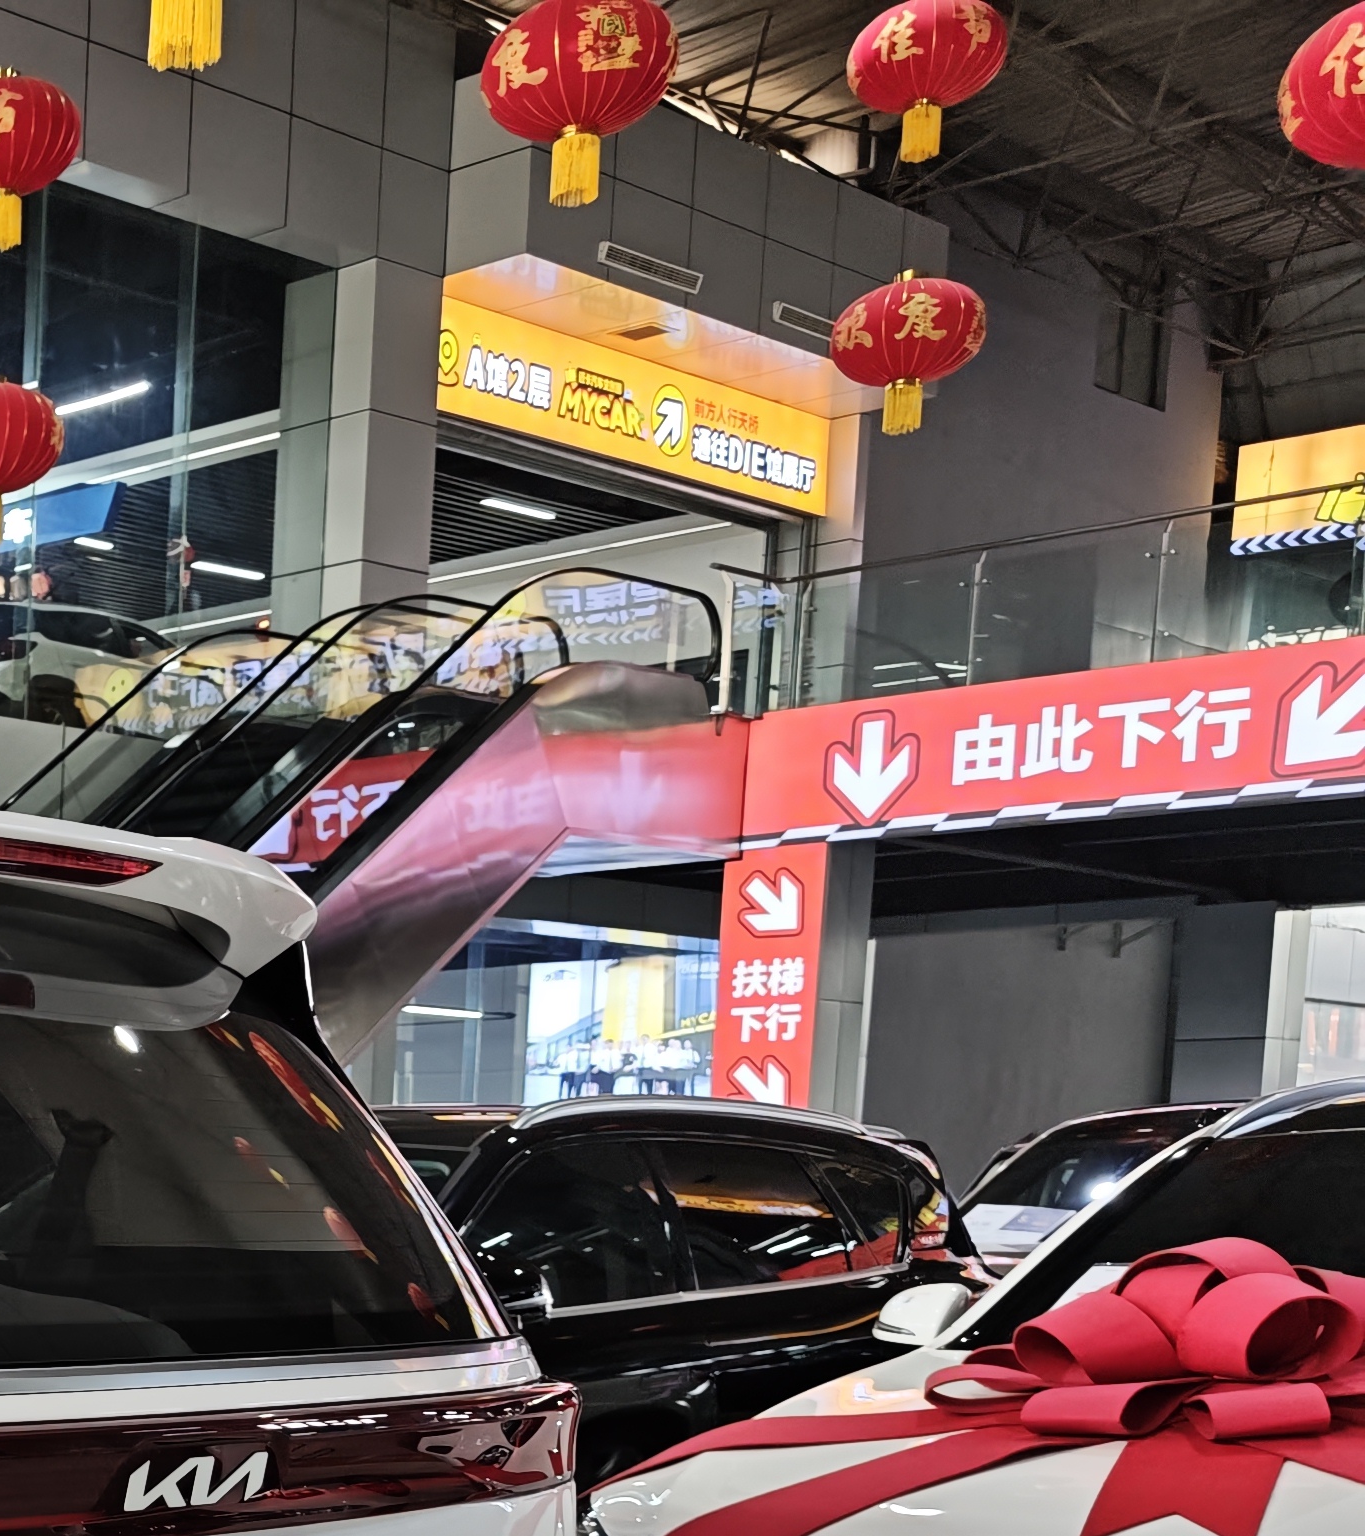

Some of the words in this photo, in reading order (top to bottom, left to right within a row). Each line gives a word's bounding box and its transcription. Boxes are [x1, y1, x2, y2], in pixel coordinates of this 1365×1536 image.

[557, 382, 646, 441] MYCAR
[951, 687, 1251, 786] 由此下行
[732, 957, 804, 998] 扶梯
[730, 1003, 801, 1043] 下行
[123, 1451, 269, 1512] KIA
